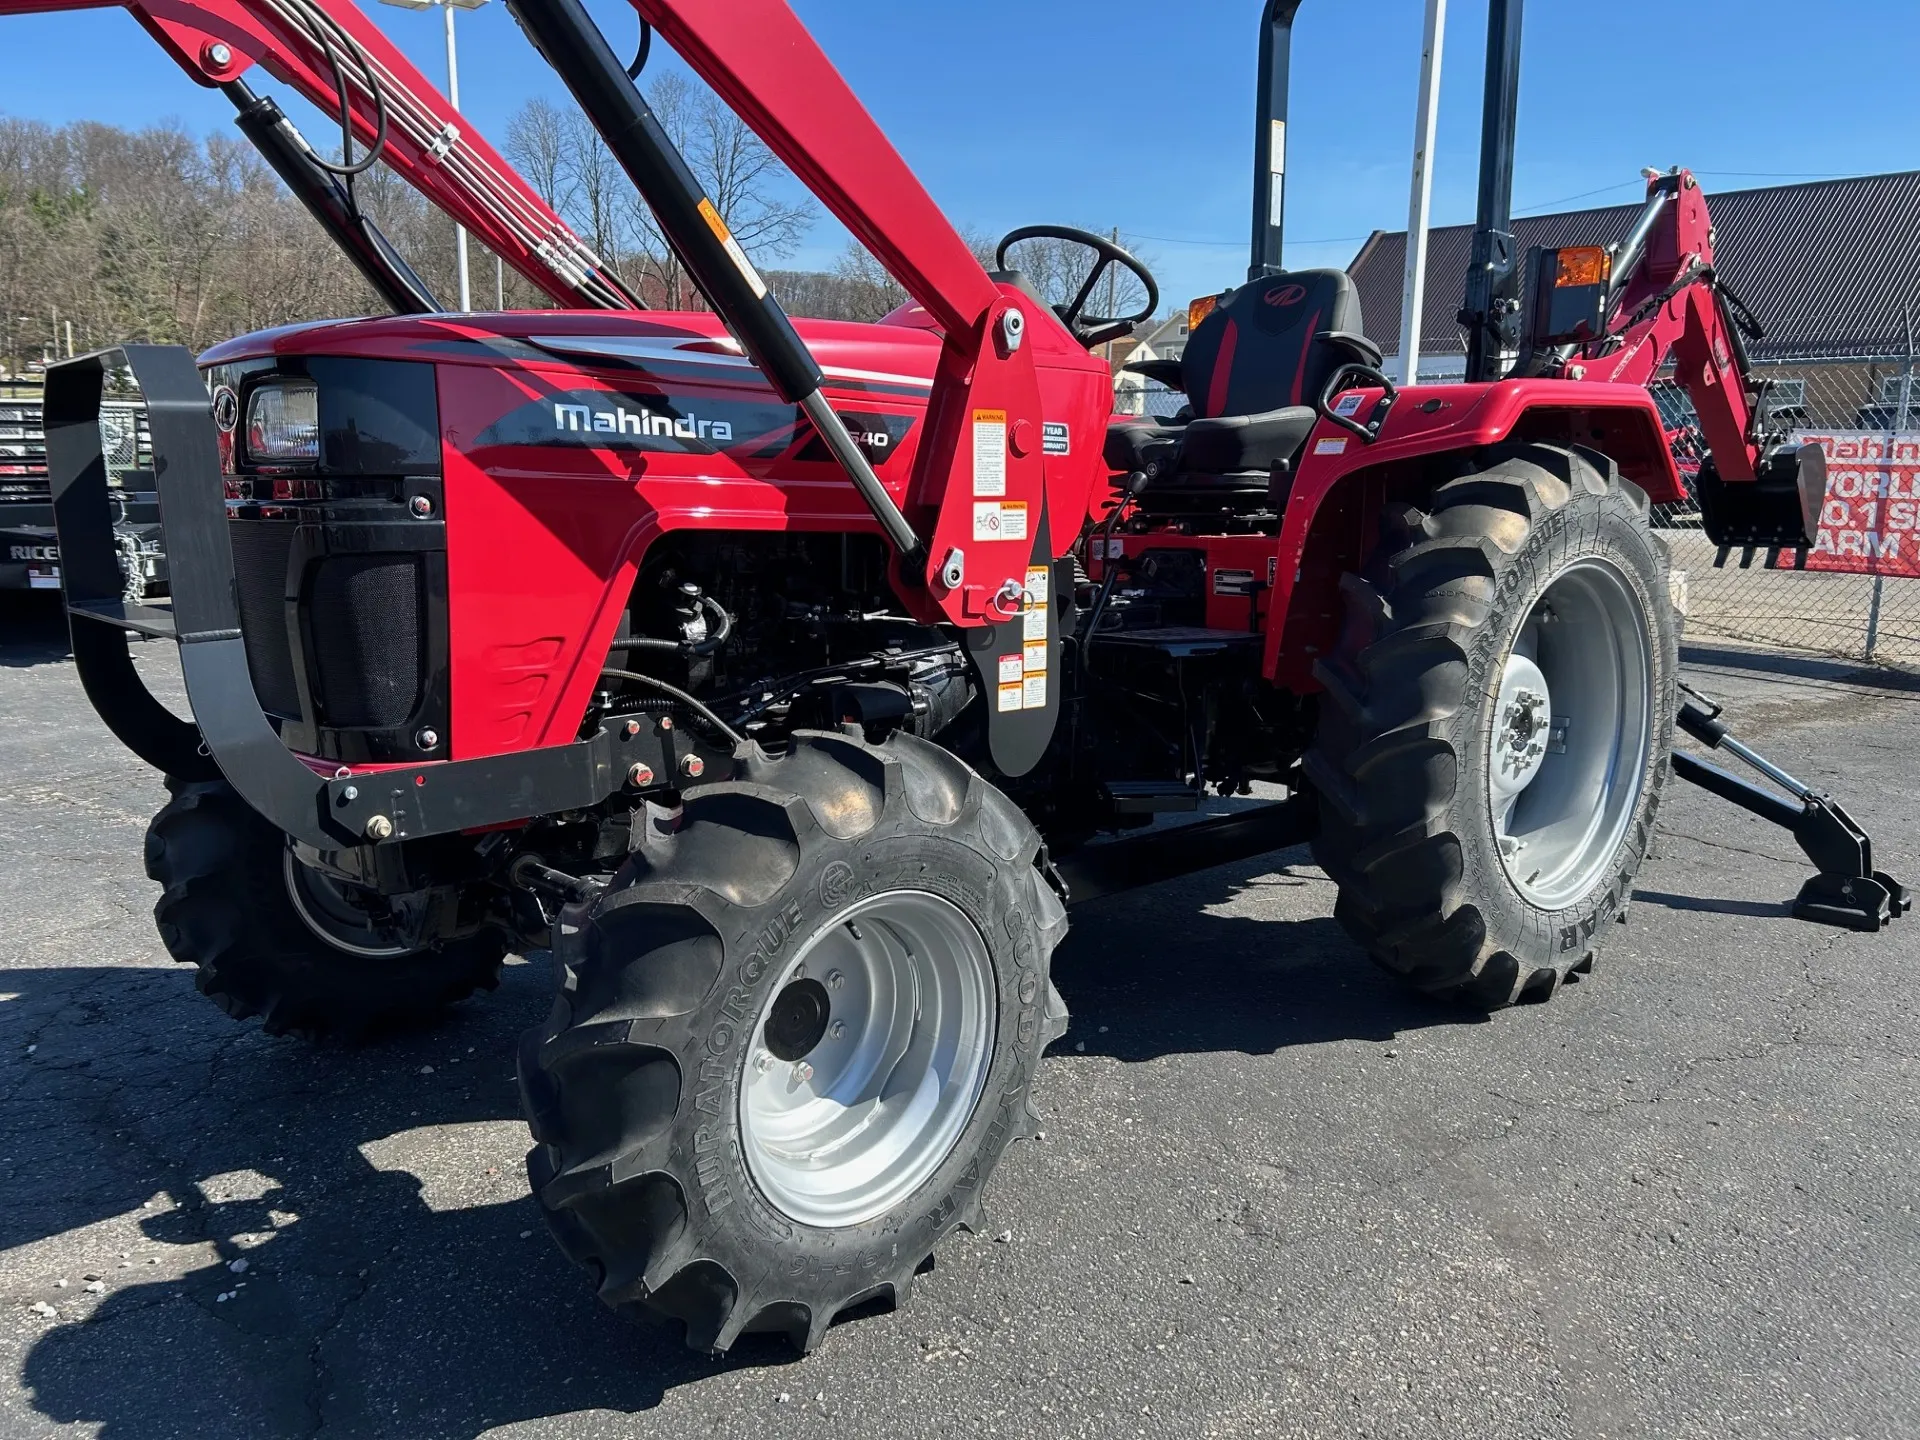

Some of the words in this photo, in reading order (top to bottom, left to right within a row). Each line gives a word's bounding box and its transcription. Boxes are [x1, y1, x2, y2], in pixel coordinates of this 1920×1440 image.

[555, 403, 732, 440] Mahindra
[1047, 427, 1062, 436] YEAR
[1825, 470, 1920, 499] ORL
[10, 545, 60, 560] RICE
[1806, 529, 1900, 559] ARM
[693, 898, 804, 1216] DURATORQUE
[927, 902, 1037, 1231] GOODYEAR
